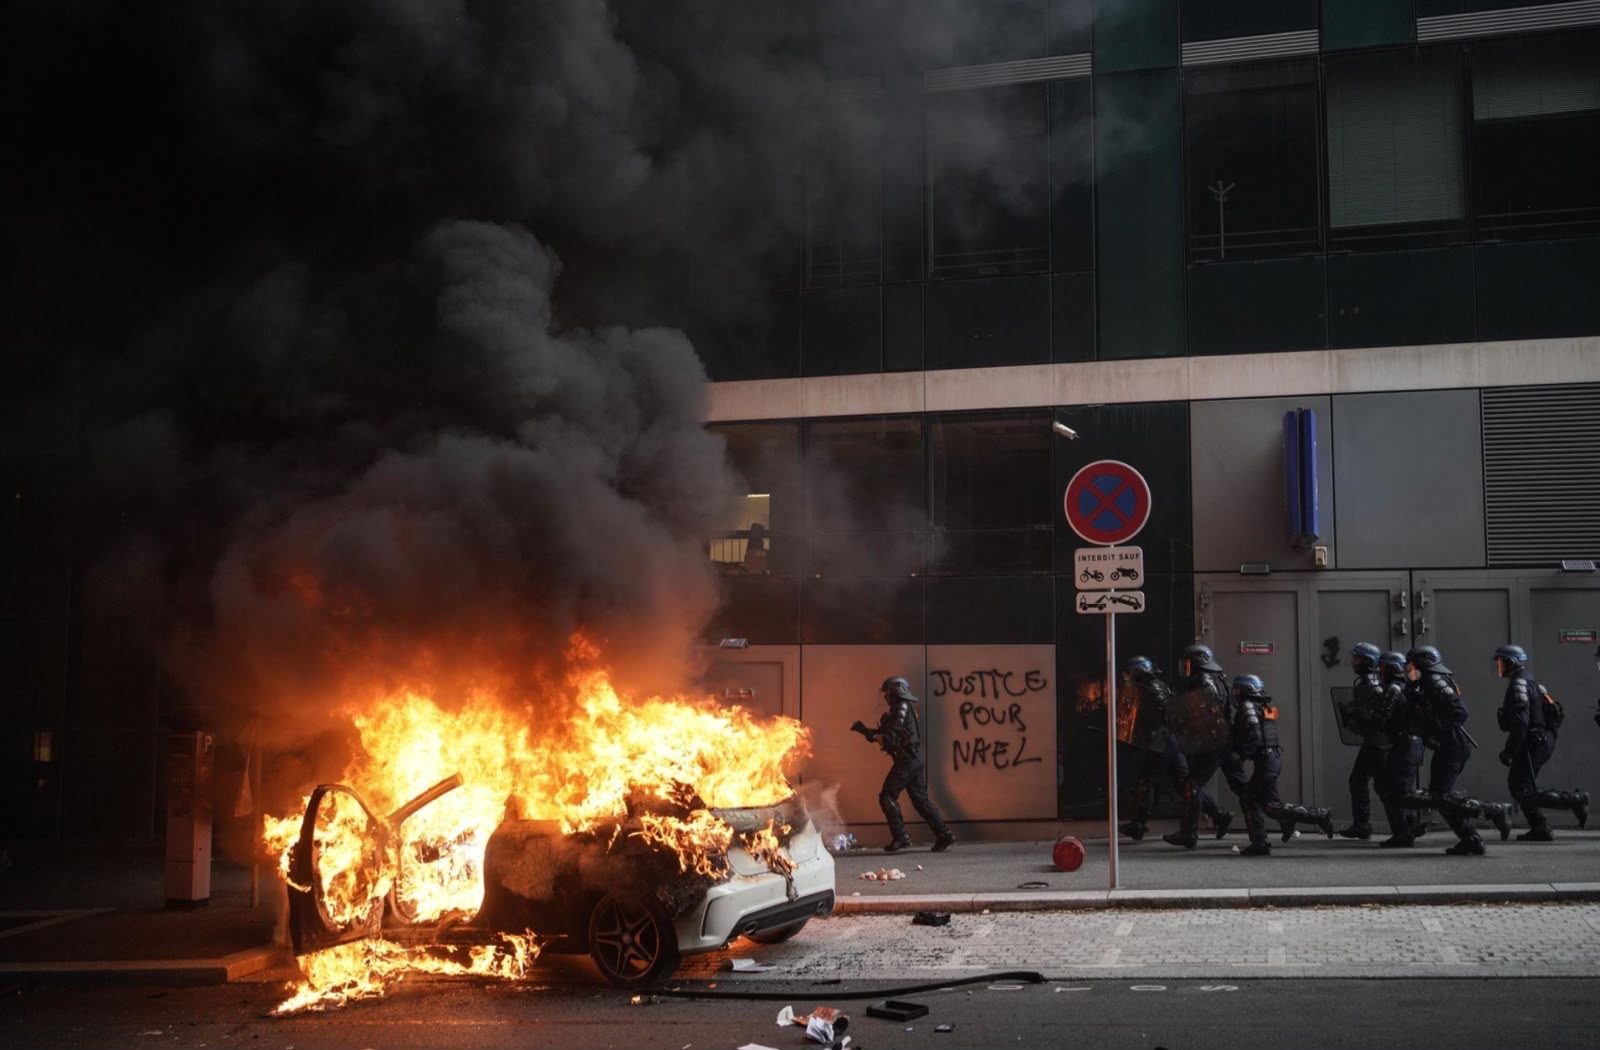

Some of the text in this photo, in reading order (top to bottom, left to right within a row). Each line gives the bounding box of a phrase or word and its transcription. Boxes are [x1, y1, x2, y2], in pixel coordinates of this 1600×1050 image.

[1078, 552, 1140, 562] INTERDIT SAUF
[930, 669, 1047, 699] JUSTICE
[959, 702, 1026, 732] POUR
[953, 736, 1042, 772] NAEL
